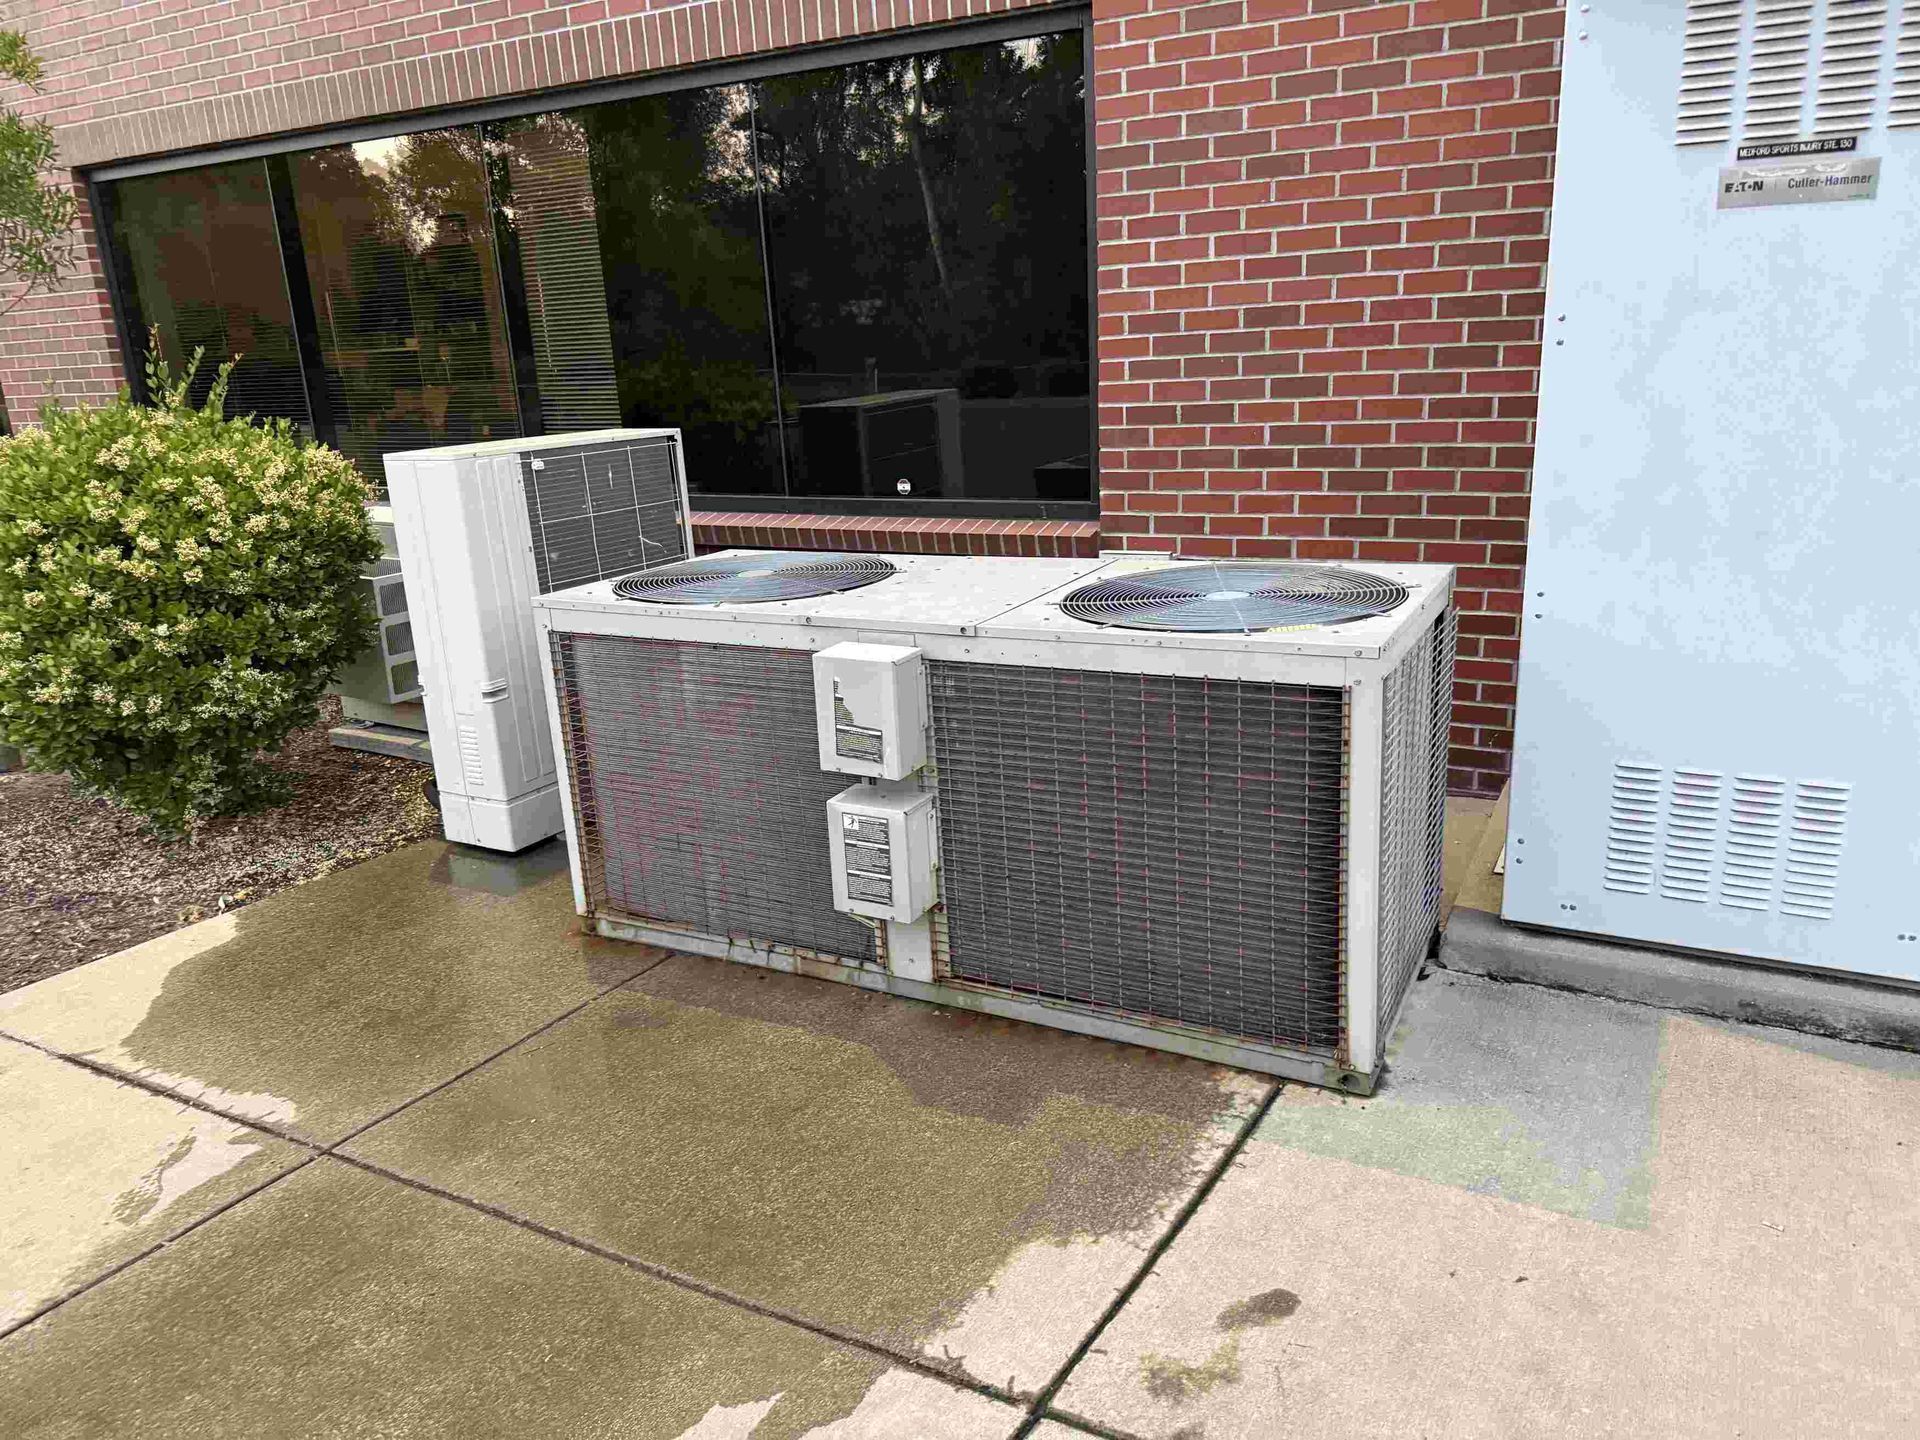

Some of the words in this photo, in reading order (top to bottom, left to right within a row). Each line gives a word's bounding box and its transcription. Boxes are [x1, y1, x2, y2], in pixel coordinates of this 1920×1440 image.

[1772, 144, 1798, 154] SPORTS
[1840, 139, 1852, 148] 130
[1788, 174, 1872, 189] Cutler-Hammer
